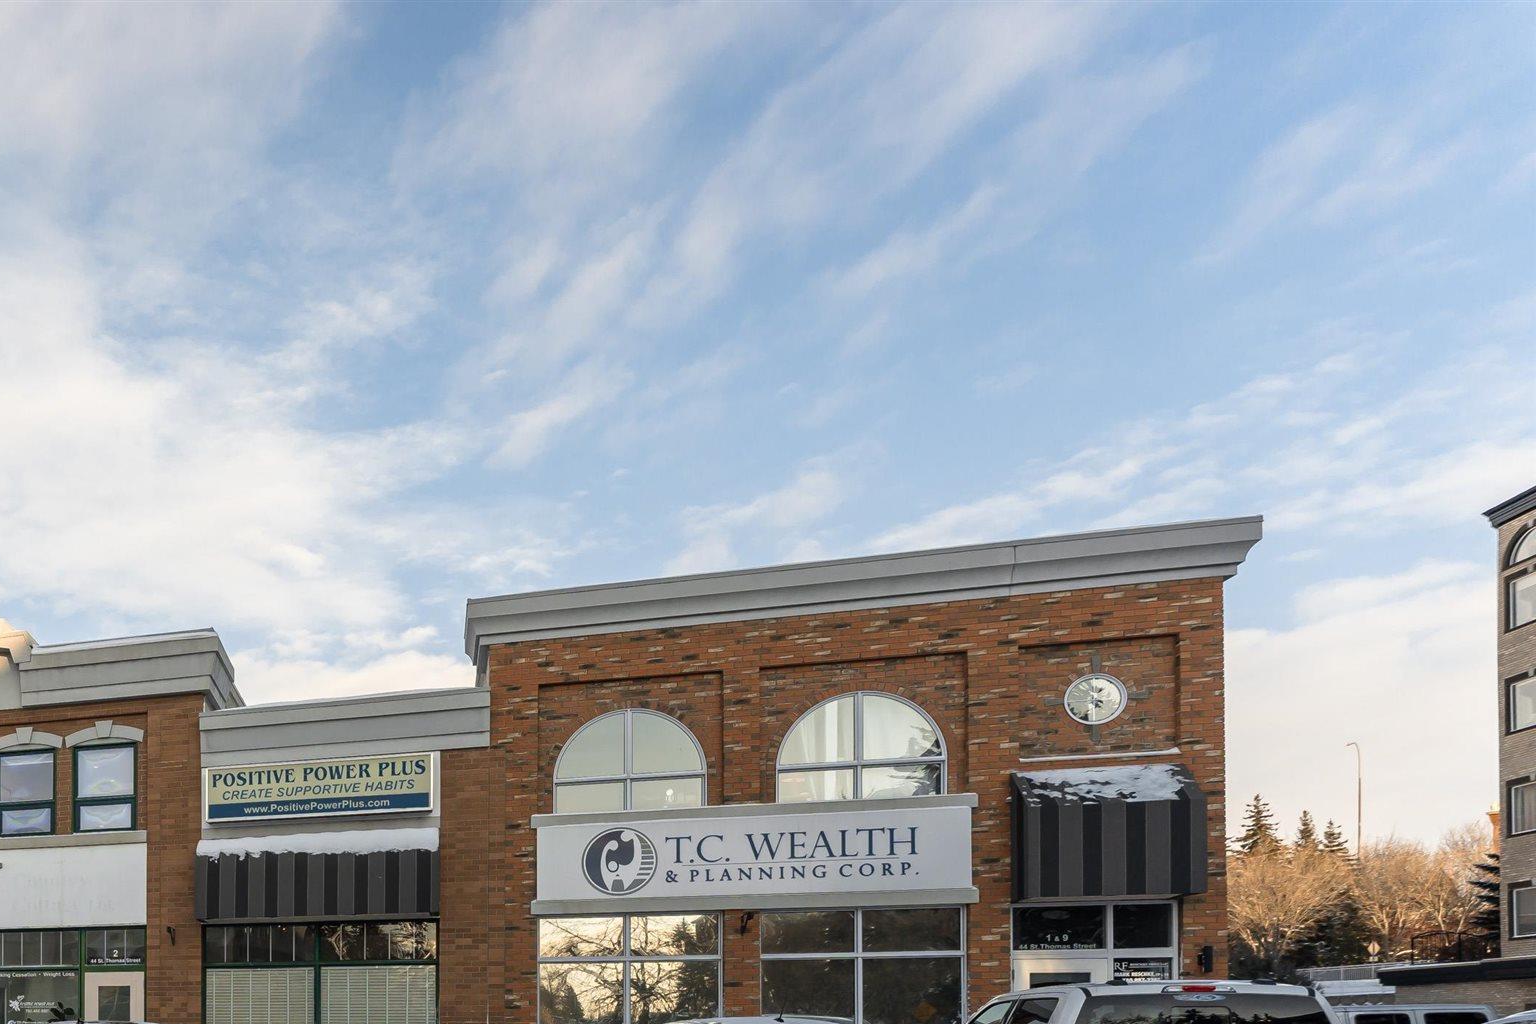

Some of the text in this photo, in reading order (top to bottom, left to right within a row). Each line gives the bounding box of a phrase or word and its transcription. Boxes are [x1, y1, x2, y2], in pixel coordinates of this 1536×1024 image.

[212, 759, 427, 787] POSITIVE POWER PLUS
[222, 779, 415, 800] CREATE SUPPORTIVE HABITS
[243, 798, 390, 814] www.PositivePowerPlus.com
[665, 827, 919, 863] T.C. WEALTH
[665, 861, 920, 883] & PLANNING CORP.
